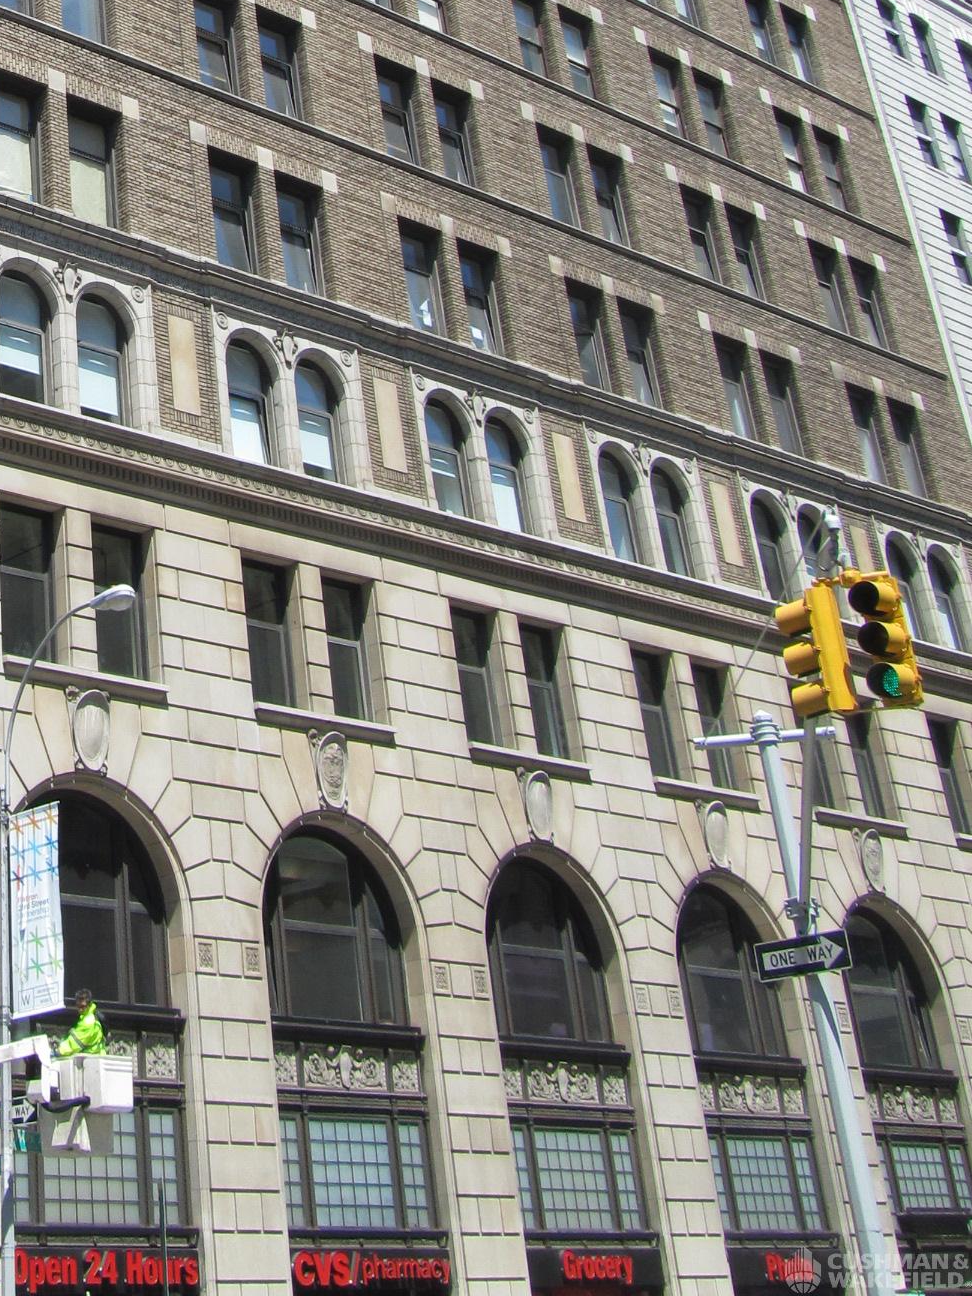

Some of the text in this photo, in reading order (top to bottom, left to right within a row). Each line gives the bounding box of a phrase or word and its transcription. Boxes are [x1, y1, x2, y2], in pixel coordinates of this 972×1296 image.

[770, 944, 833, 967] ONE WAY
[15, 1106, 30, 1116] WAY
[15, 1248, 199, 1293] Open 24 Hours
[294, 1250, 451, 1287] CVS/pharmacy
[562, 1249, 633, 1285] Grocery
